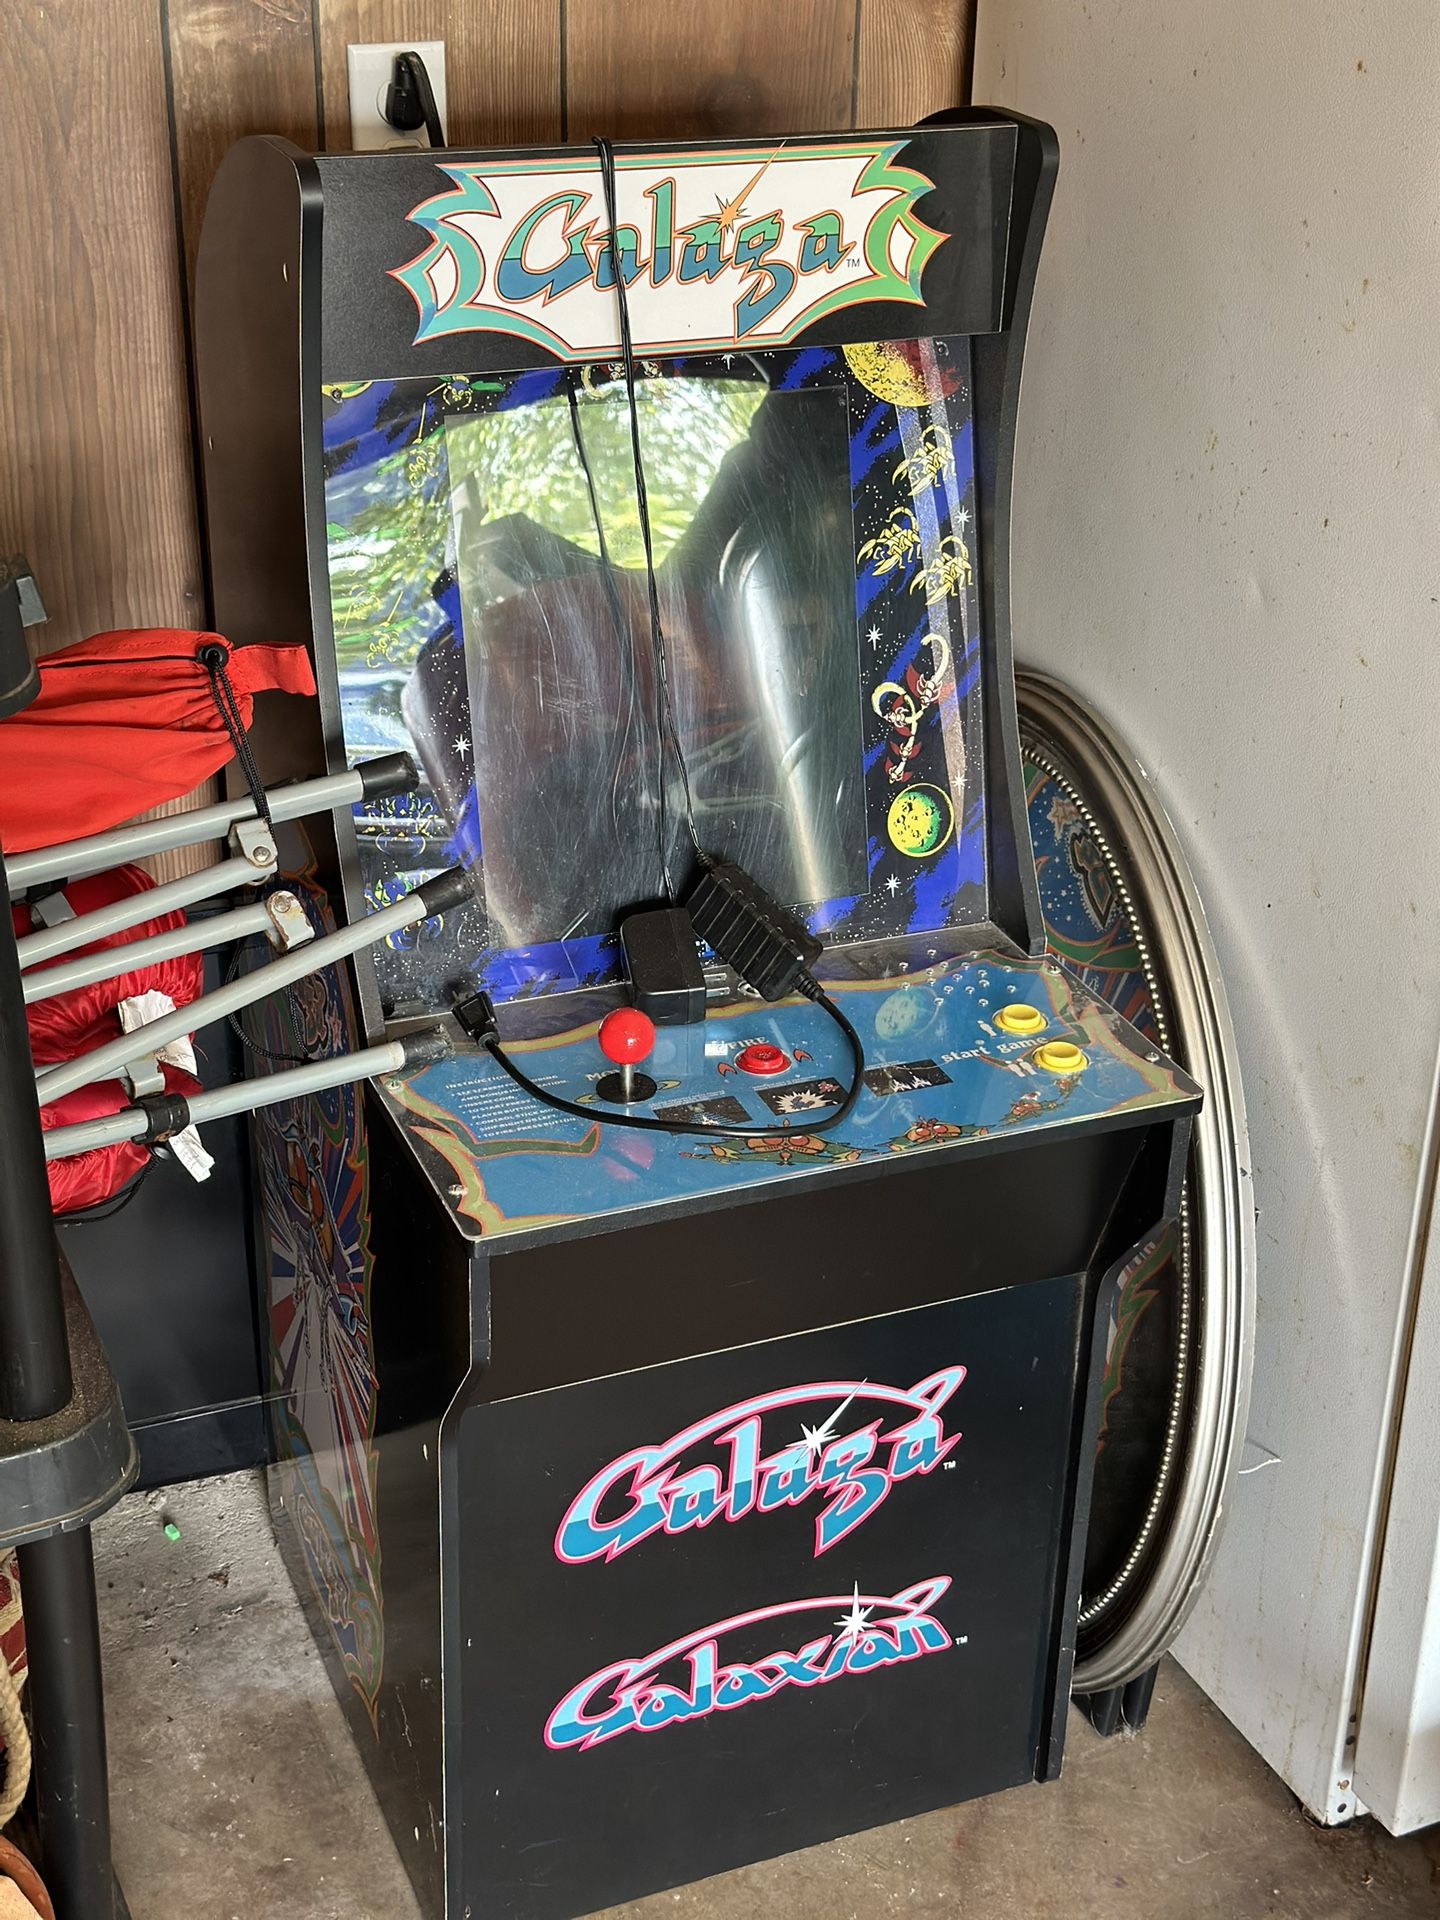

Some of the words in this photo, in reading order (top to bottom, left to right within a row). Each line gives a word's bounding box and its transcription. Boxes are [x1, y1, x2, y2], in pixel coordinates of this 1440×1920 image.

[494, 176, 857, 344] Galaga
[846, 258, 860, 268] TM
[445, 1074, 512, 1089] INSTRUCTION
[727, 1036, 769, 1049] FIRE
[940, 1046, 991, 1064] start
[996, 1035, 1049, 1054] game
[554, 1365, 967, 1563] Galaga
[943, 1460, 957, 1470] TM
[543, 1575, 953, 1752] Galaxian
[955, 1635, 968, 1646] TM
